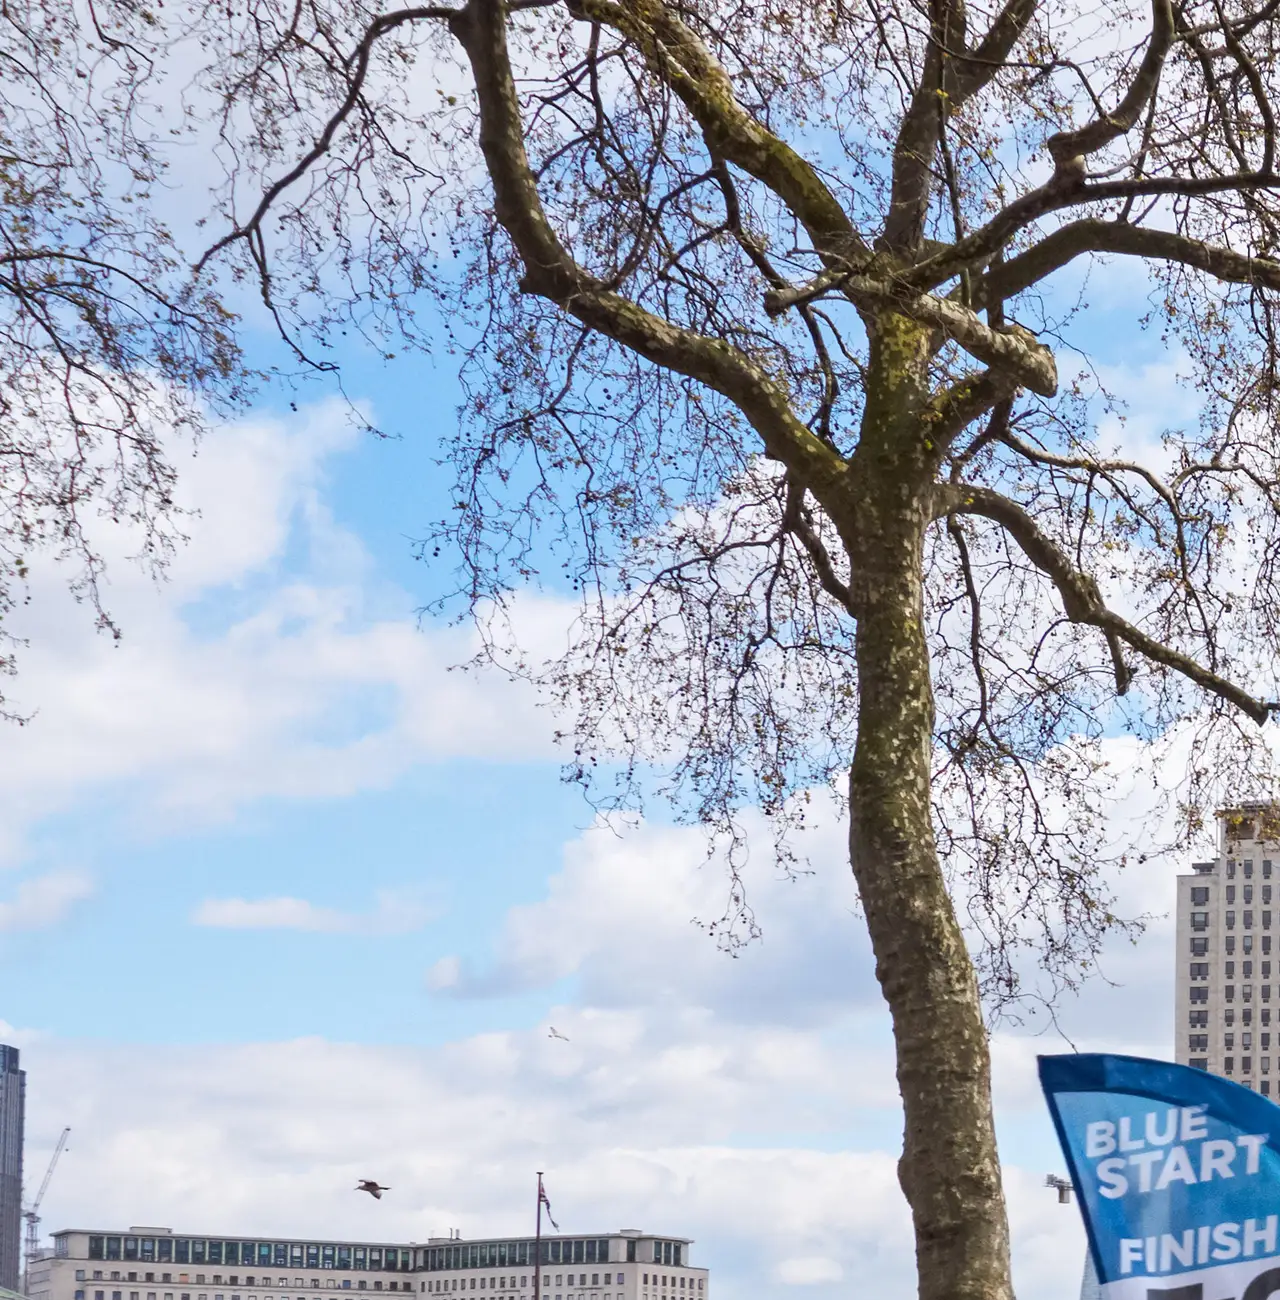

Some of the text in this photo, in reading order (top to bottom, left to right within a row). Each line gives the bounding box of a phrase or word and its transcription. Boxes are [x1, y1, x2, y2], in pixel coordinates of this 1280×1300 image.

[1086, 1103, 1209, 1159] BLUE
[1095, 1133, 1270, 1200] START
[1119, 1218, 1278, 1275] FINISH
